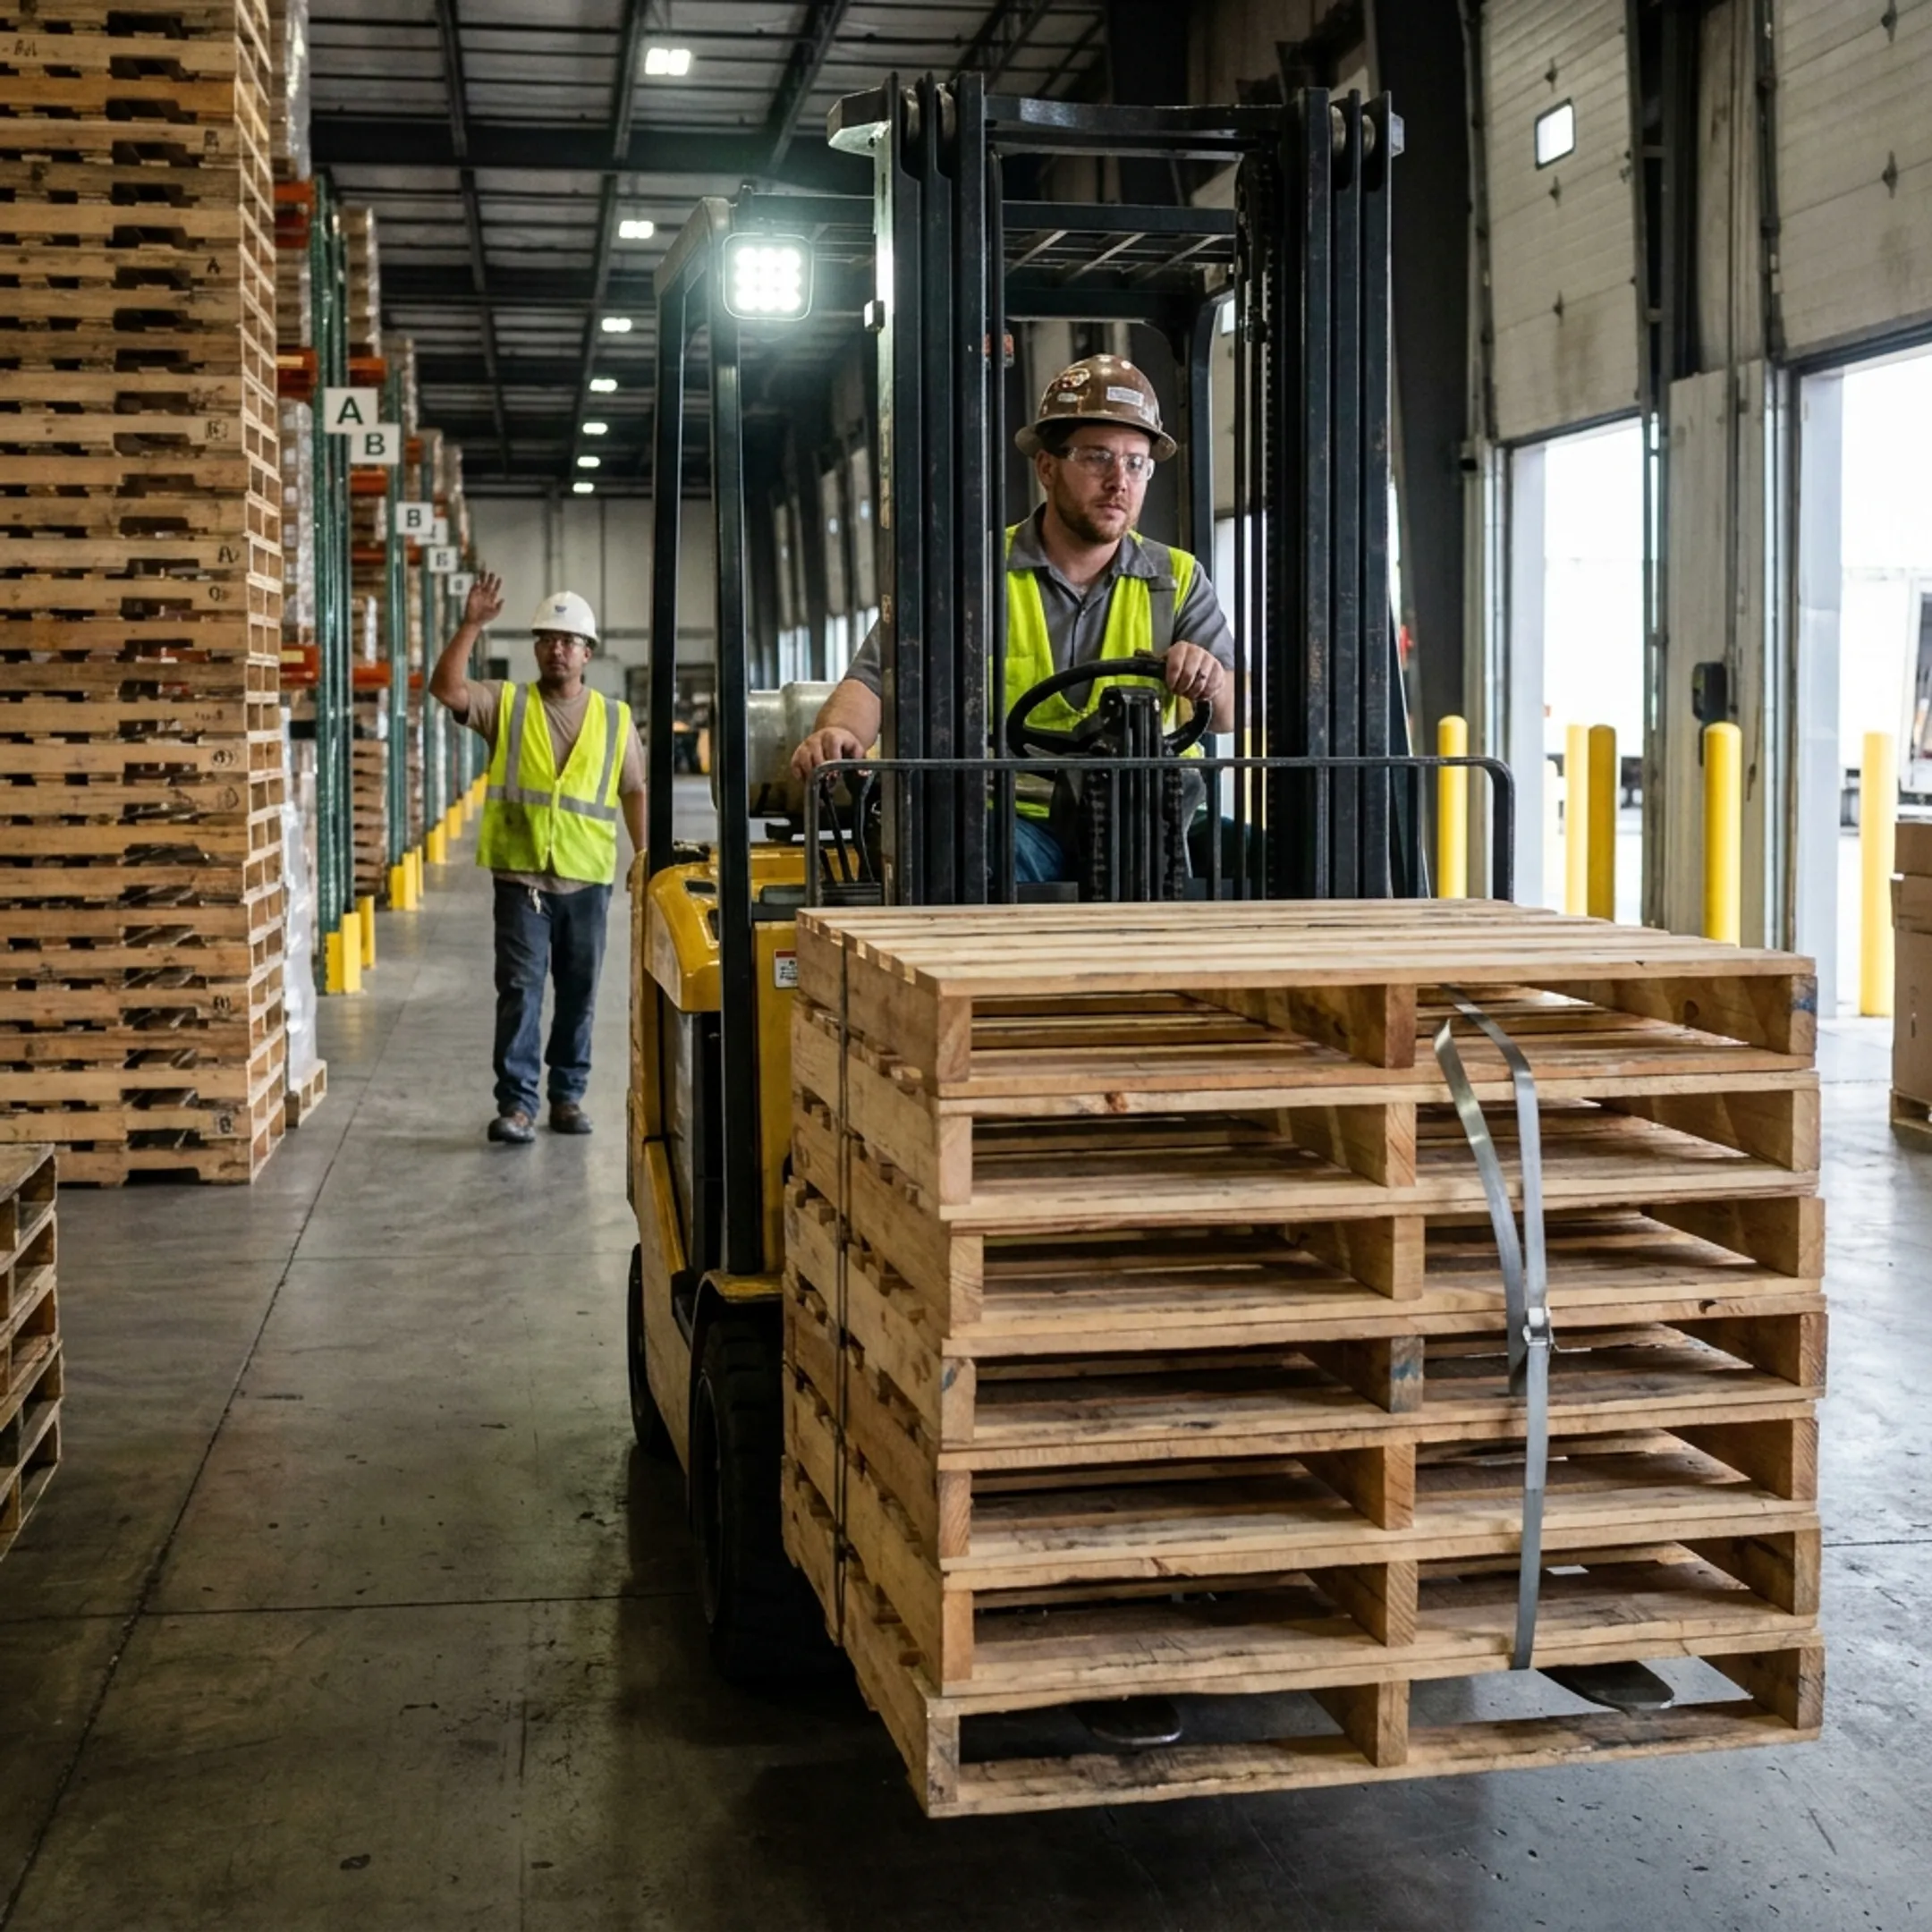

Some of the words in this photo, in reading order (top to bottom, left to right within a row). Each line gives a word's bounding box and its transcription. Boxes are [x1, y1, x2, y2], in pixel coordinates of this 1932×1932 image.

[336, 396, 364, 425] A
[365, 433, 386, 456] B
[406, 508, 421, 528] B
